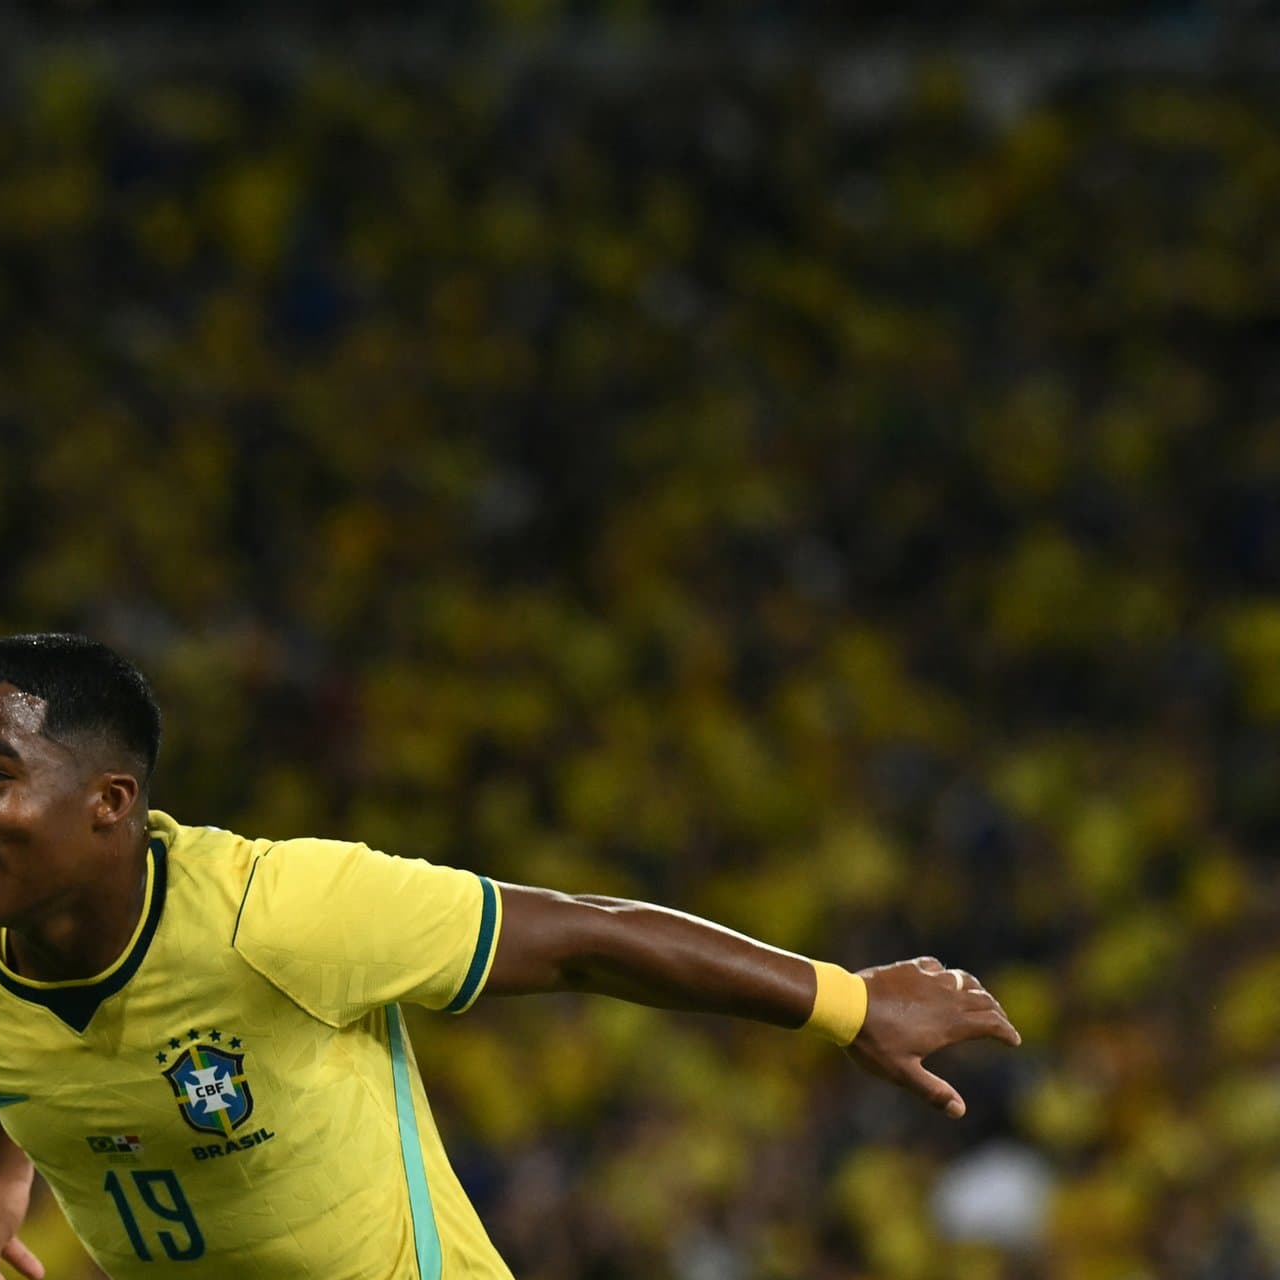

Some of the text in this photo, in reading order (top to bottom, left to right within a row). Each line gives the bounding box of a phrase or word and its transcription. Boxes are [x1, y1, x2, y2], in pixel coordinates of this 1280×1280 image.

[195, 1081, 226, 1099] CBF
[191, 1127, 275, 1162] BRASIL
[103, 1169, 207, 1263] 19
